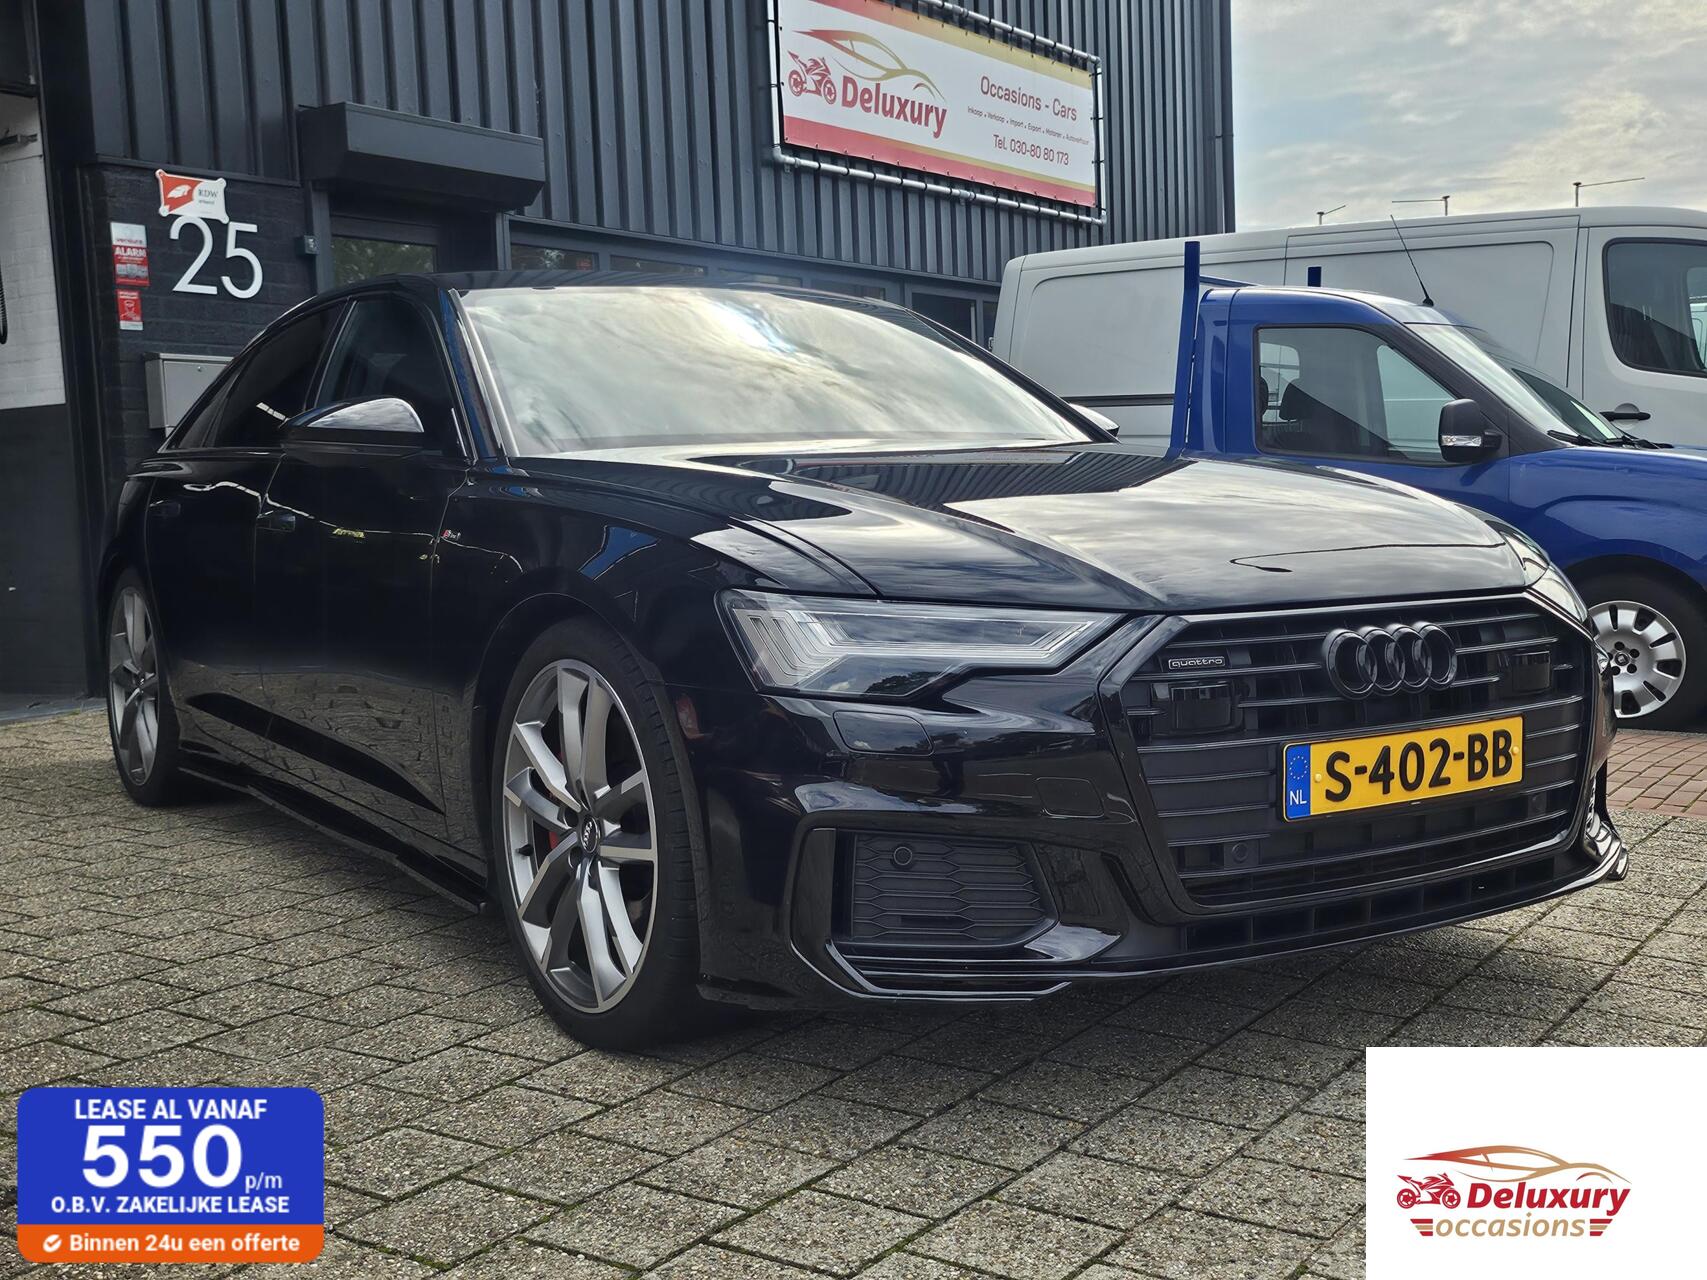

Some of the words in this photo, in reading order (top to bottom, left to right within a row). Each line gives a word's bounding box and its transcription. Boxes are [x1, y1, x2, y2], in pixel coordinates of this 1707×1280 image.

[841, 75, 948, 139] Deluxury
[980, 75, 1042, 111] Occasions
[1052, 98, 1077, 121] Cars
[1009, 138, 1041, 159] 030-80
[1043, 147, 1055, 162] 80
[1056, 151, 1070, 166] 173
[114, 246, 147, 258] ALARM
[170, 215, 263, 299] 25
[1171, 658, 1223, 668] quattro
[1324, 728, 1514, 803] S-402-BB
[1289, 789, 1308, 806] NL
